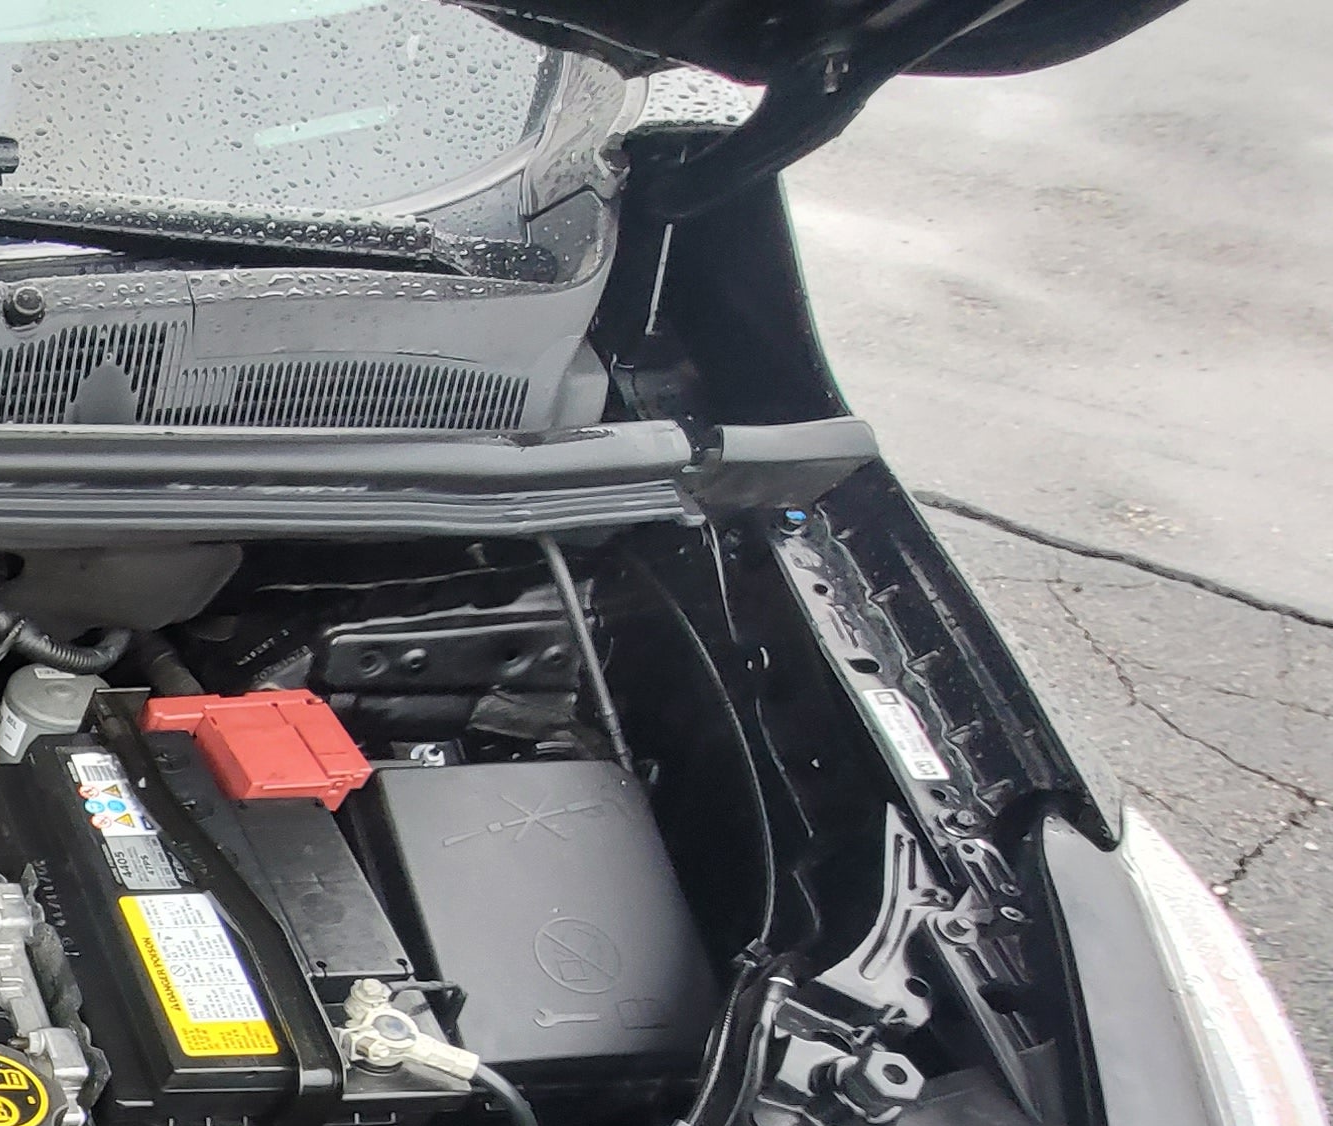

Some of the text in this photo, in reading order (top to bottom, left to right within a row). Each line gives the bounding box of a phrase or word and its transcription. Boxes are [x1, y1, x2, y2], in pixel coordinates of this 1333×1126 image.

[114, 851, 132, 878] 4405
[142, 936, 177, 1005] DANGER POISON
